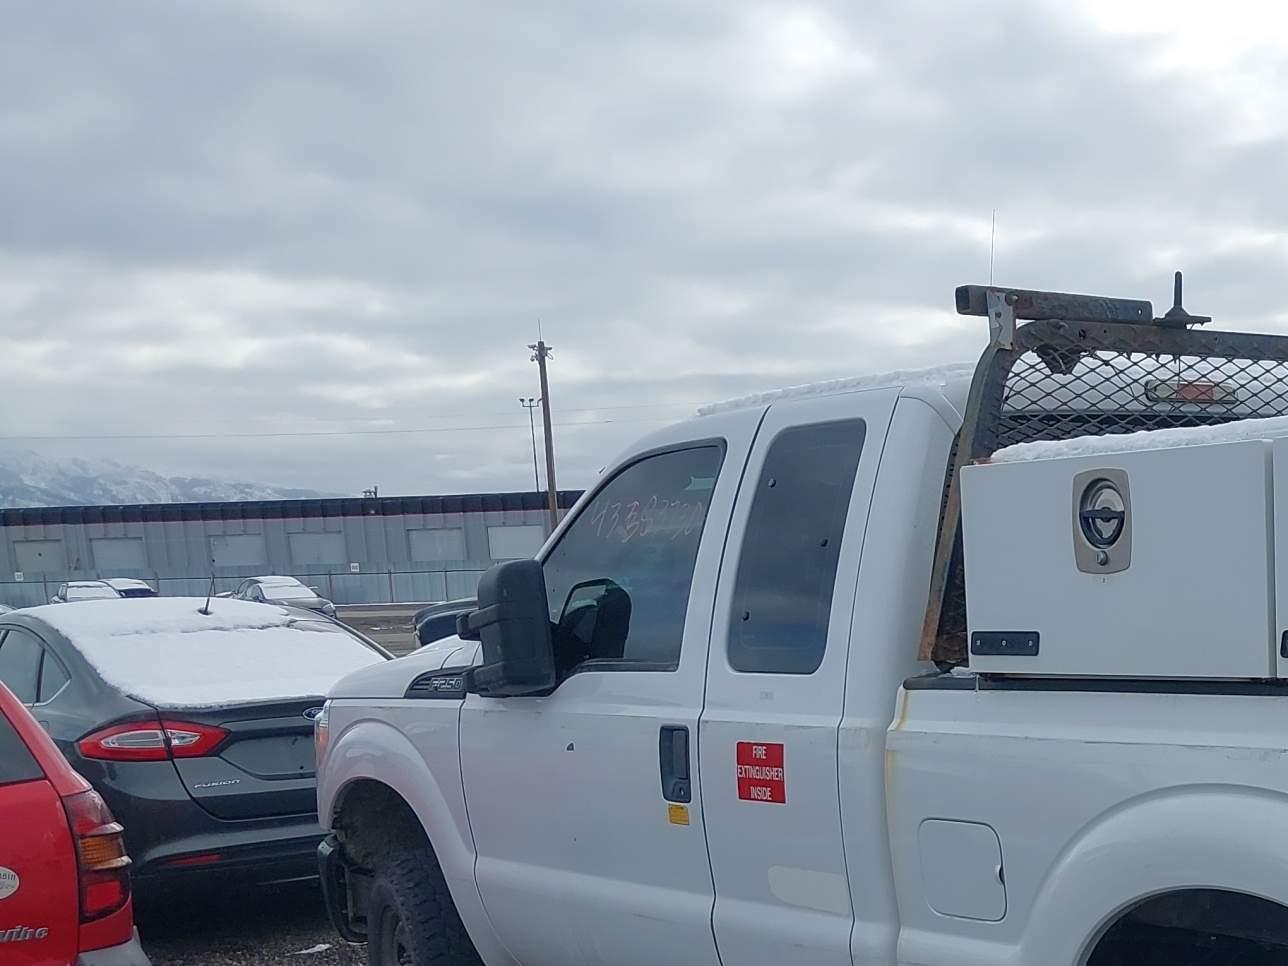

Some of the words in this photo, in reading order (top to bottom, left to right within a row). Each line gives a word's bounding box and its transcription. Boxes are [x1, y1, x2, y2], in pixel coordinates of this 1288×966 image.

[752, 745, 768, 760] FIRE
[737, 764, 784, 781] EXTINGUISHER
[750, 785, 772, 801] INSIDE
